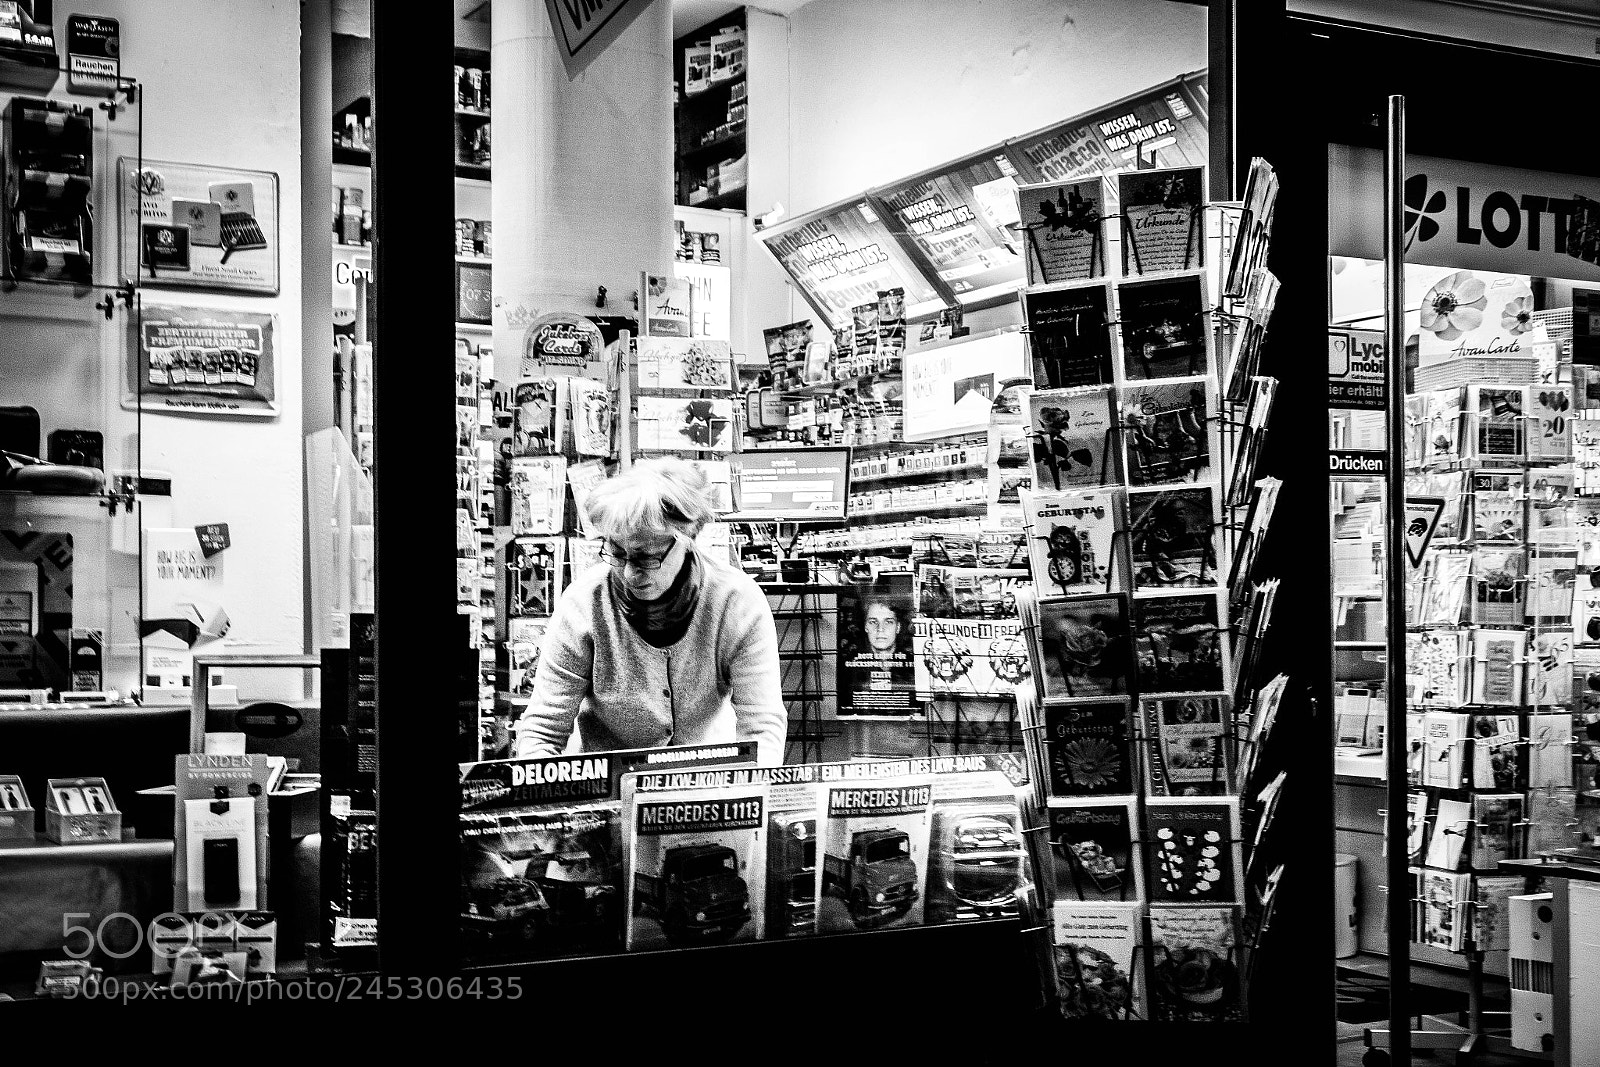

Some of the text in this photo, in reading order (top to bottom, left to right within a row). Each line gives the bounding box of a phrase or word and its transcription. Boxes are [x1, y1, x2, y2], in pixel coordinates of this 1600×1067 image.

[75, 59, 114, 72] Rauchen
[1099, 113, 1142, 137] WISSEN,
[1104, 118, 1176, 152] WAS DRIN IST.
[900, 197, 943, 221] WISSEN,
[909, 204, 977, 236] WAS DRIN IST.
[1135, 215, 1185, 230] Urkunde
[1456, 186, 1573, 255] LOTT
[1045, 231, 1084, 243] Urkunde
[539, 323, 590, 345] Jukebox
[542, 339, 582, 355] Cards
[1543, 416, 1566, 438] 20
[1329, 455, 1383, 471] Drücken
[1037, 506, 1104, 518] GEBURTSTAG
[188, 550, 197, 564] IS
[1079, 531, 1092, 584] SPORT
[929, 623, 979, 640] FREUNDE
[1056, 723, 1115, 738] Geburtstag
[187, 755, 253, 768] LYNDEN
[511, 758, 609, 786] DELOREAN
[642, 756, 987, 790] DIE LKW-IKONE IM MASSSTAB EIN MEILENSTEIN DES LKW-BAUS
[513, 778, 608, 801] ZEITMASCHINE
[831, 790, 899, 809] MERCEDES
[902, 787, 930, 806] L1113
[641, 800, 760, 825] MERCEDES L1113
[1056, 813, 1122, 826] Geburtstag
